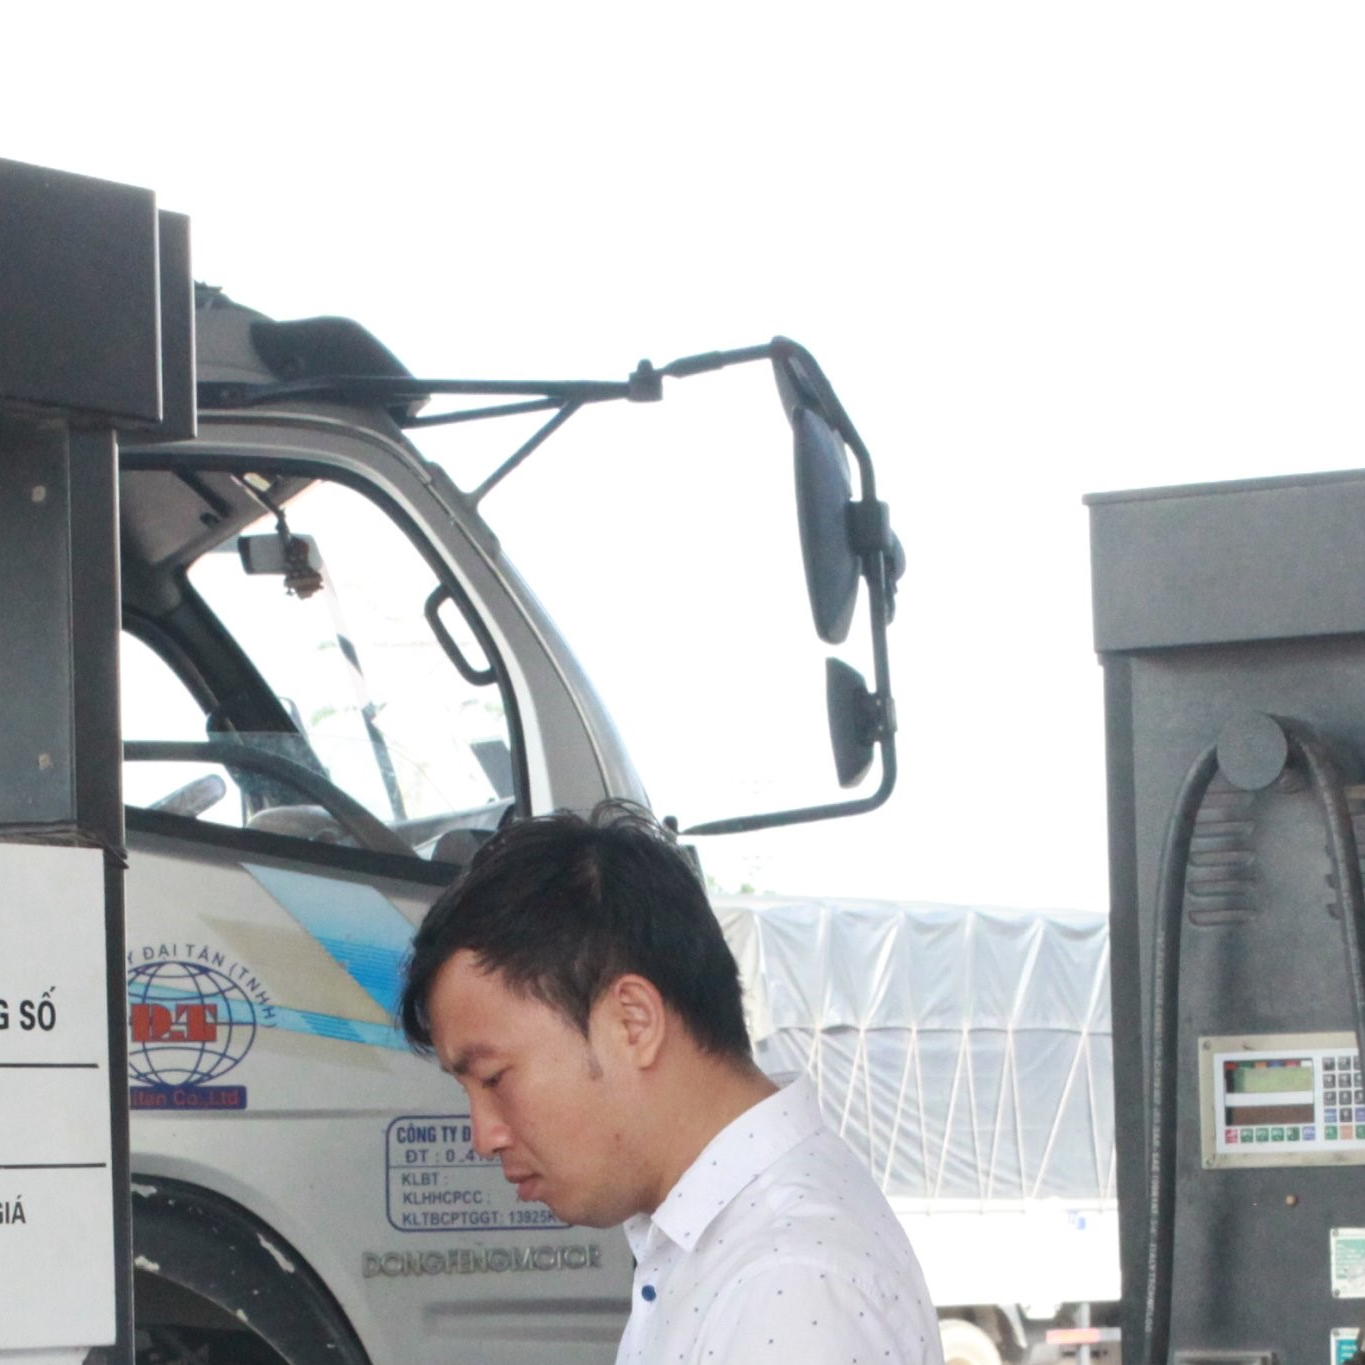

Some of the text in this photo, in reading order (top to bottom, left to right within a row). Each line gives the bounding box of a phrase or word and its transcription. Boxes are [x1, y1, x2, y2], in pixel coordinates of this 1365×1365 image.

[19, 985, 57, 1031] SỐ
[396, 1122, 437, 1143] CÔNG
[441, 1125, 457, 1143] TY
[401, 1172, 440, 1187] KLBT
